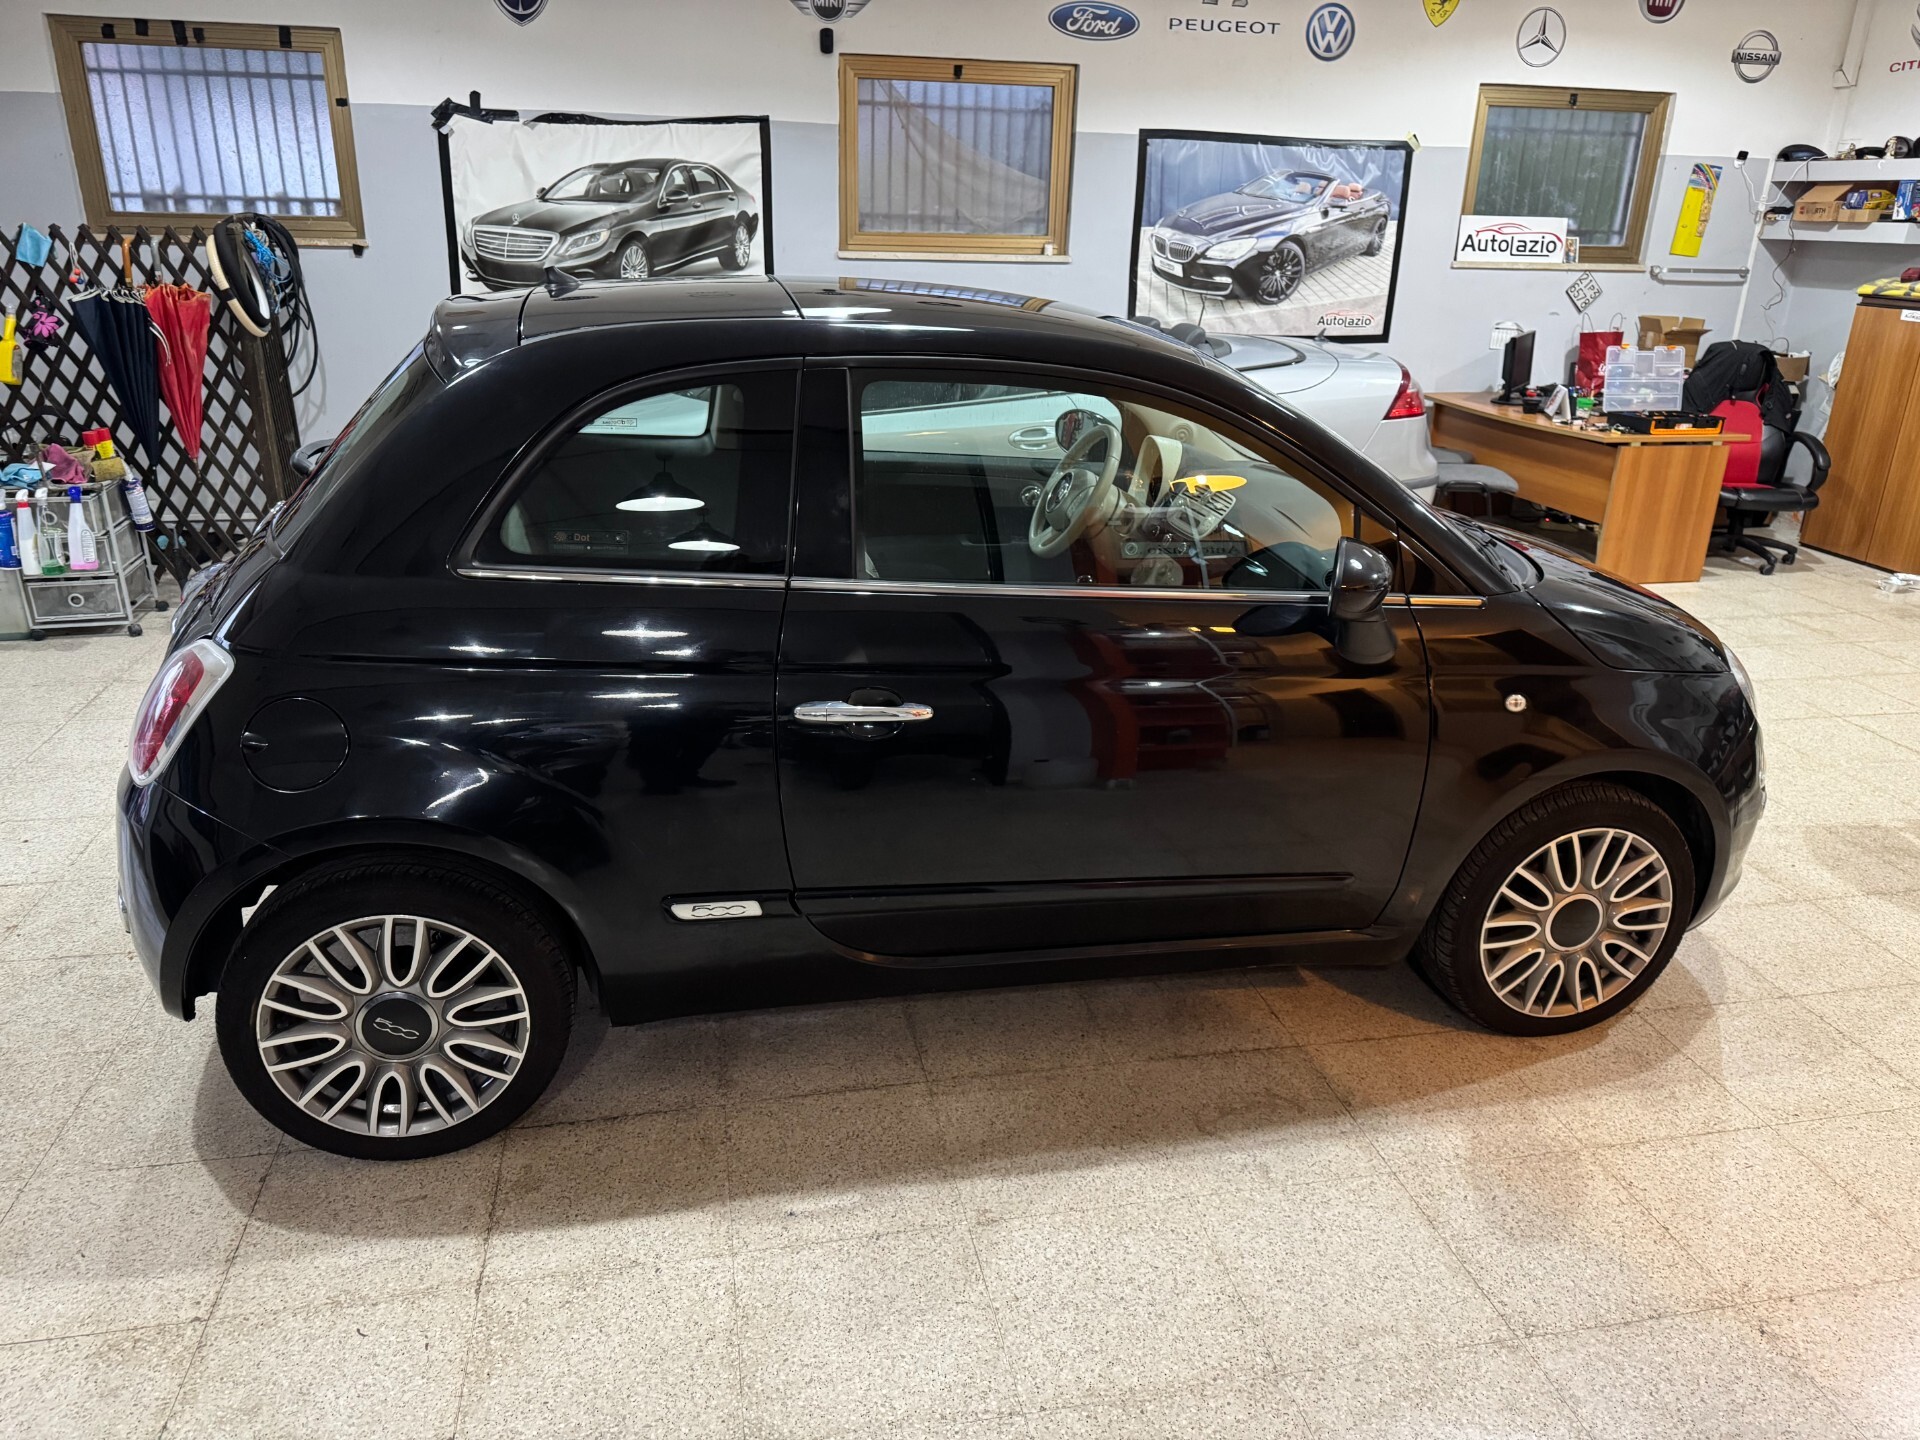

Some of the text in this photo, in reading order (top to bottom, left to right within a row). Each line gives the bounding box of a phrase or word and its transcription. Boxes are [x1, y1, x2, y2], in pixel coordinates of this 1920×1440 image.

[1066, 6, 1121, 35] Ford
[1169, 17, 1281, 35] PEUGEOT
[1736, 52, 1776, 62] NISSAN
[1889, 60, 1920, 73] CIT
[691, 905, 747, 917] 500
[373, 1017, 420, 1039] 500
